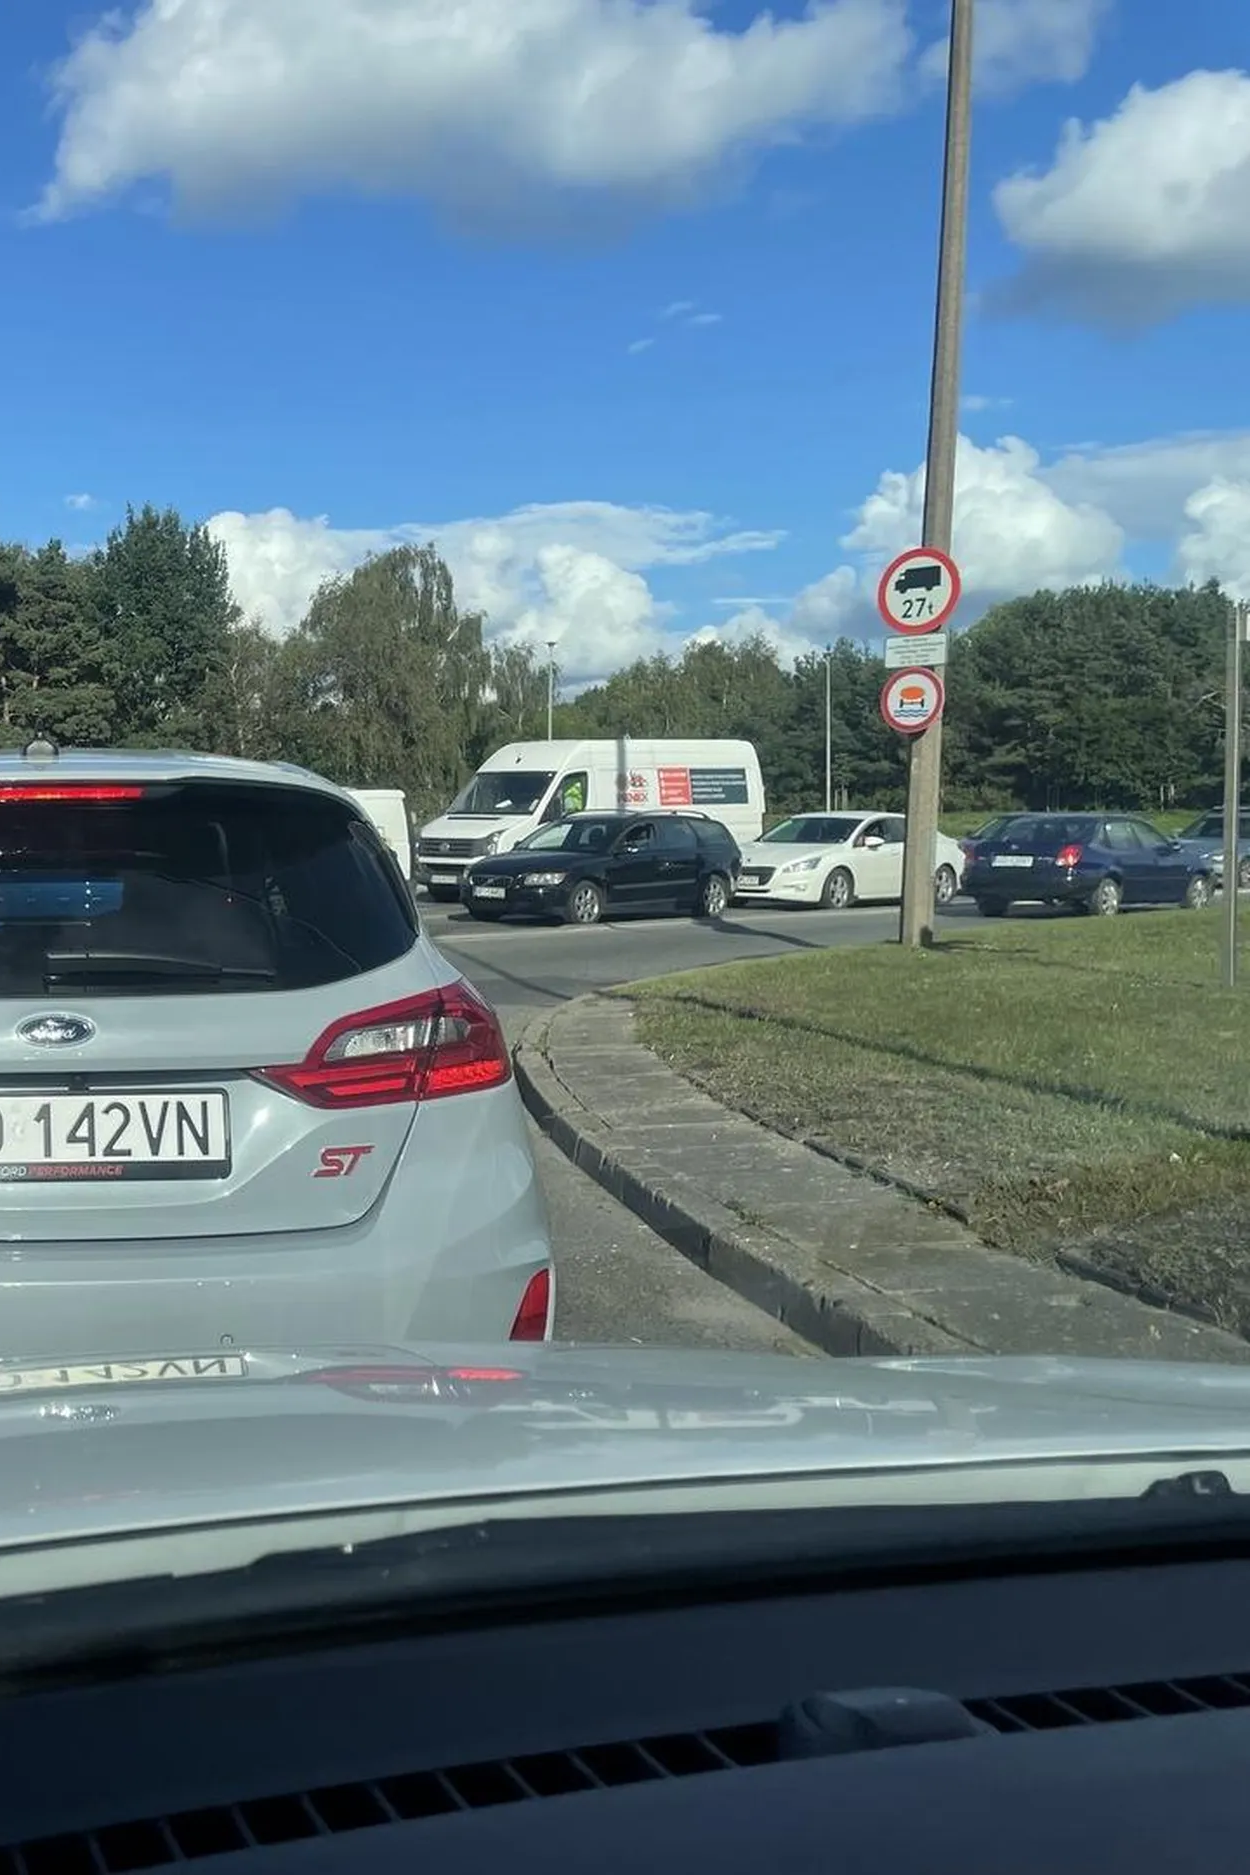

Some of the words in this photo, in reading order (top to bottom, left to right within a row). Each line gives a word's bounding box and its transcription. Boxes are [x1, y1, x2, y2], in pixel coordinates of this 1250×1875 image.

[34, 1100, 210, 1158] 142VN
[28, 1164, 125, 1177] PERFORMANCE
[310, 1144, 375, 1177] ST
